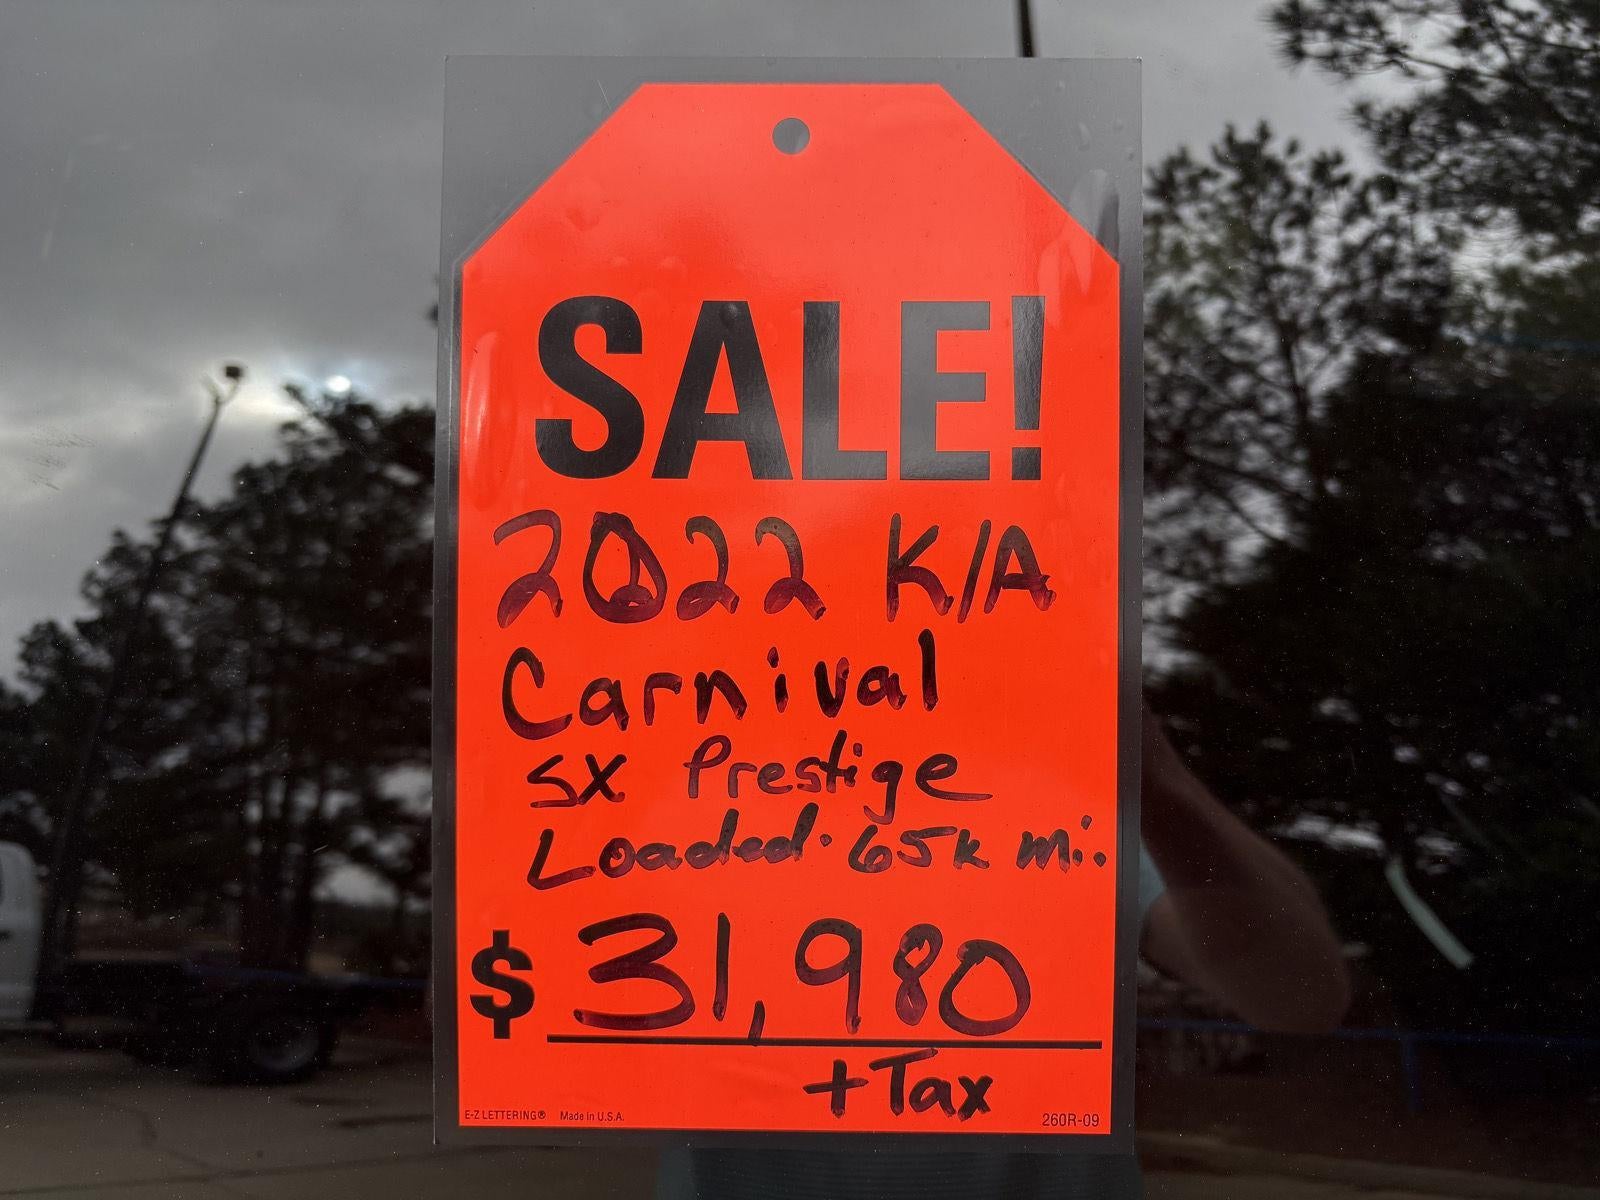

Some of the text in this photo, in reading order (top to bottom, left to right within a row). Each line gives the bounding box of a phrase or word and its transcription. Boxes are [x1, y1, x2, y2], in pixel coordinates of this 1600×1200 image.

[535, 295, 1046, 482] SALE!
[493, 509, 827, 628] 2022
[502, 629, 938, 740] Carnival
[682, 729, 994, 825] Prestige
[464, 1110, 480, 1120] E-Z
[560, 1111, 584, 1121] Made
[586, 1111, 595, 1121] in
[597, 1112, 626, 1122] U.S.A.
[1042, 1112, 1100, 1127] 260R-09
